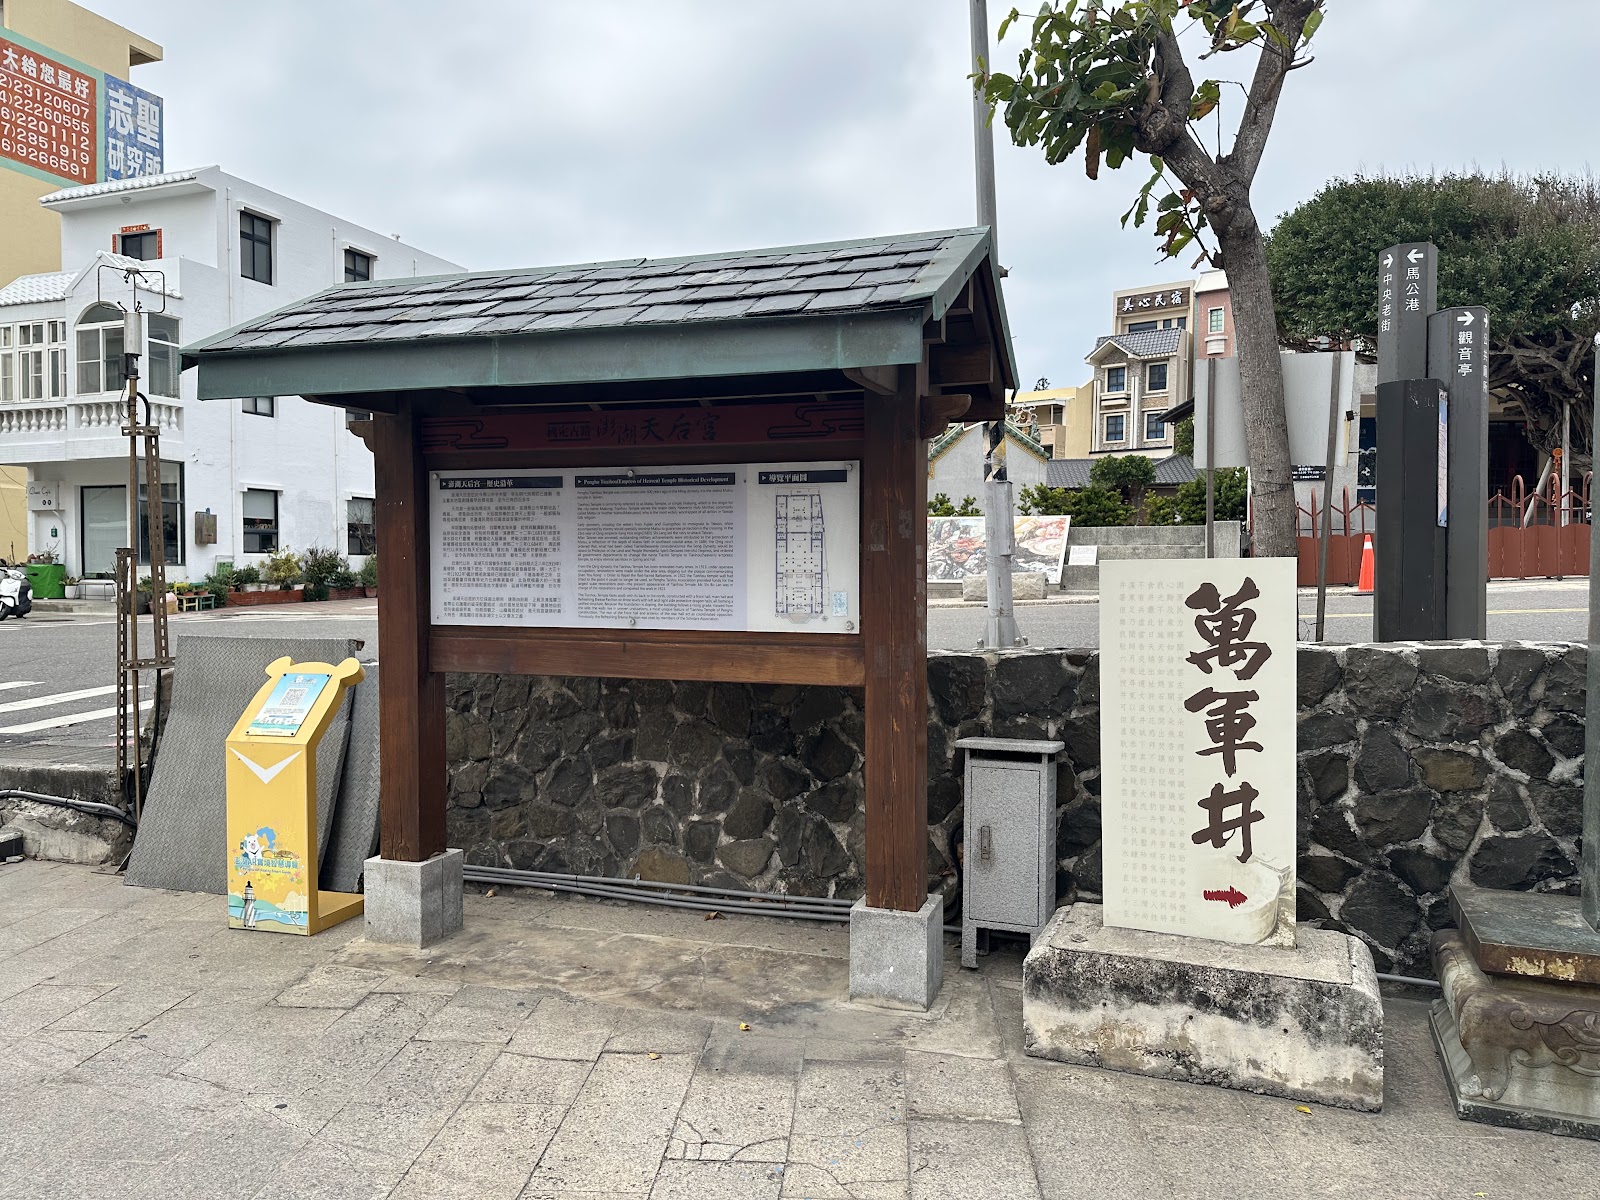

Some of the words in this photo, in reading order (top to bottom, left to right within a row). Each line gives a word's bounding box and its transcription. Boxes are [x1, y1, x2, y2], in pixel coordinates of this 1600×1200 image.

[108, 88, 160, 149] 志聖
[108, 137, 161, 177] 研究所
[1122, 291, 1183, 312] 美心民宿
[1381, 272, 1393, 333] 中央老街
[1405, 267, 1420, 312] 馬公港
[1457, 330, 1473, 377] 觀音亭
[1184, 576, 1272, 864] 萬軍井
